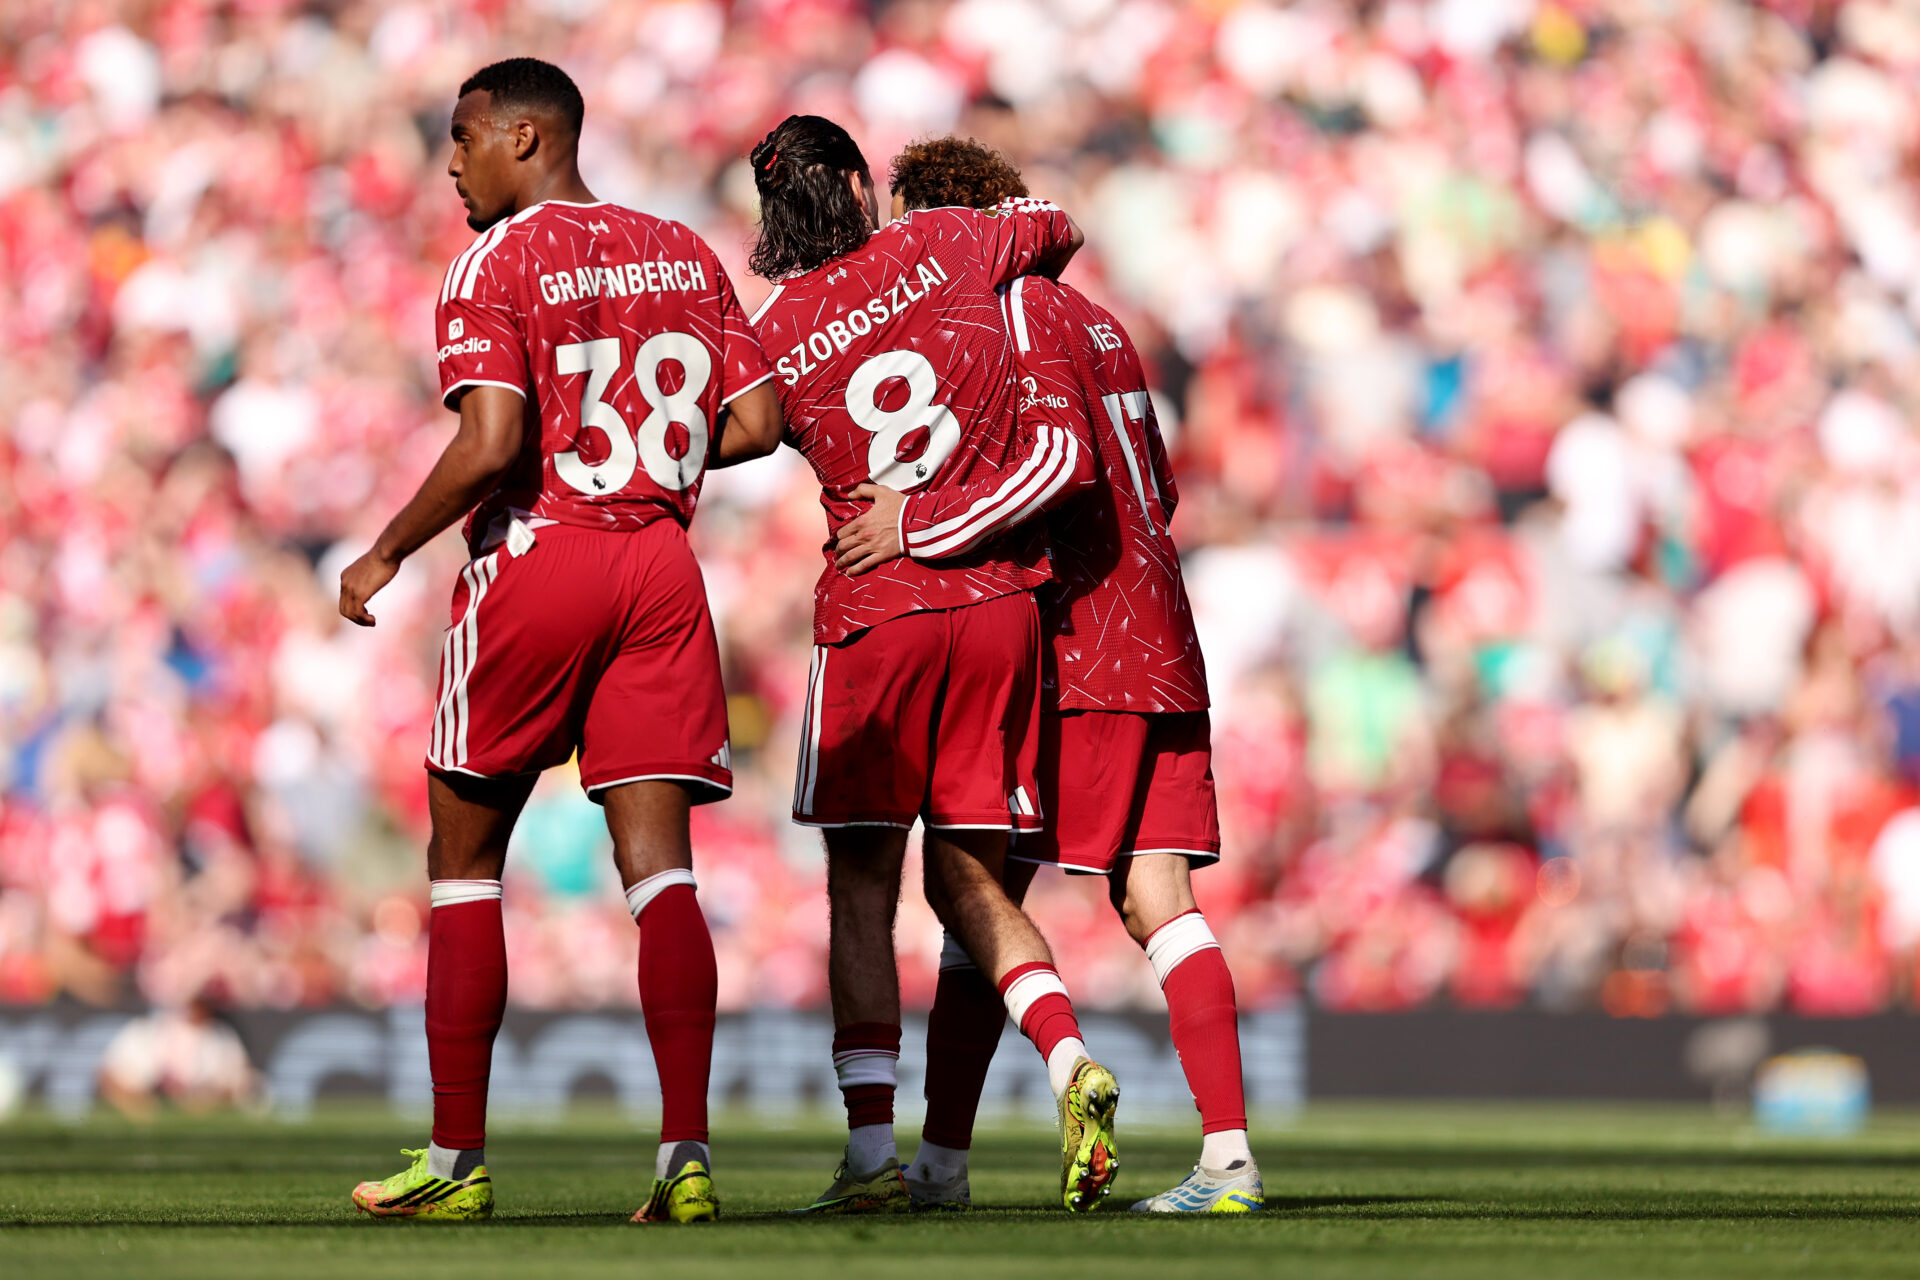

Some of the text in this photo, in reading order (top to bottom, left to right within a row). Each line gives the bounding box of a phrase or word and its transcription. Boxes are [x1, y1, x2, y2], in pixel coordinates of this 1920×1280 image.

[776, 256, 949, 386] SZOBOSZLAI
[553, 331, 712, 496] 38
[845, 349, 961, 491] 8
